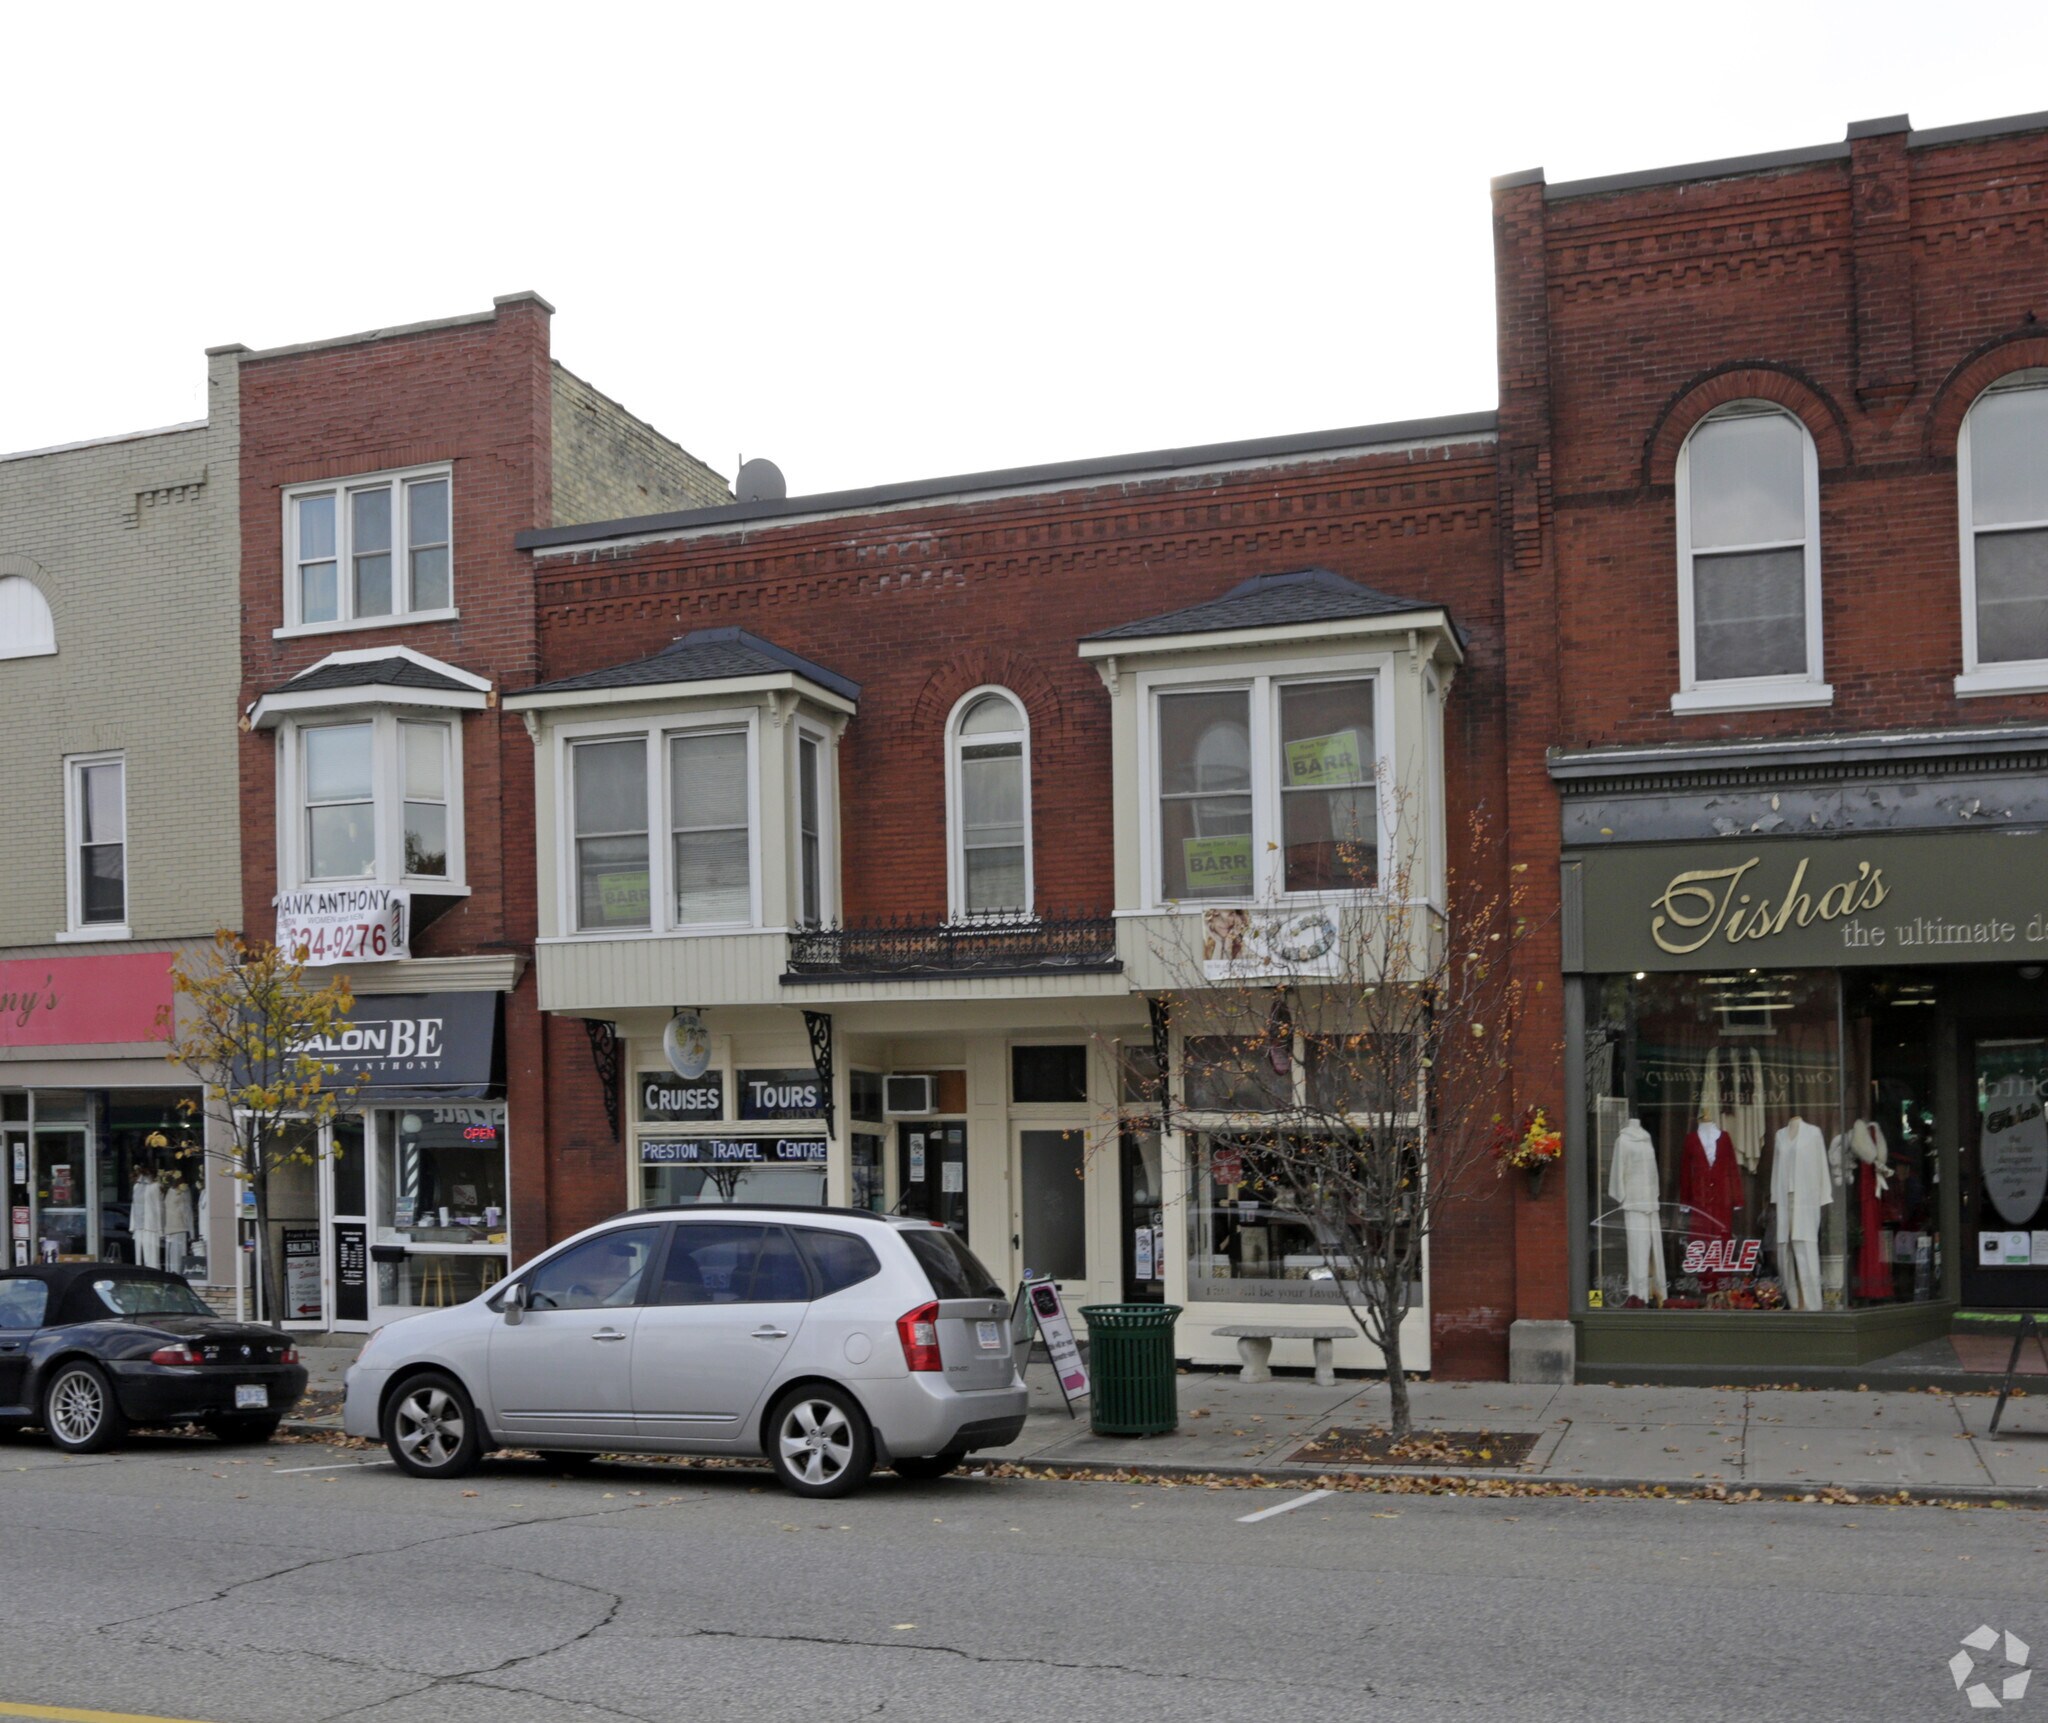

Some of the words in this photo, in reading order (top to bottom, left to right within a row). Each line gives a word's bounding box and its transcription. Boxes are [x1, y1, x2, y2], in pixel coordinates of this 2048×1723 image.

[1293, 751, 1353, 776] BARR
[1190, 854, 1249, 873] BARR
[278, 894, 314, 915] ANK
[317, 889, 391, 914] ANTHONY
[1651, 856, 1891, 954] Tisha's
[1841, 918, 1886, 947] the
[1894, 916, 2016, 945] ultimate
[2026, 912, 2048, 943] d
[387, 1018, 443, 1058] BE
[352, 1061, 442, 1071] ANTHONY
[645, 1084, 720, 1111] CRUISES
[748, 1081, 817, 1108] TOURS
[463, 1128, 497, 1139] OPEN
[641, 1141, 698, 1159] PRESTON
[708, 1140, 762, 1158] TRAVEL
[776, 1139, 826, 1158] CENTRE
[1683, 1239, 1761, 1273] SALE
